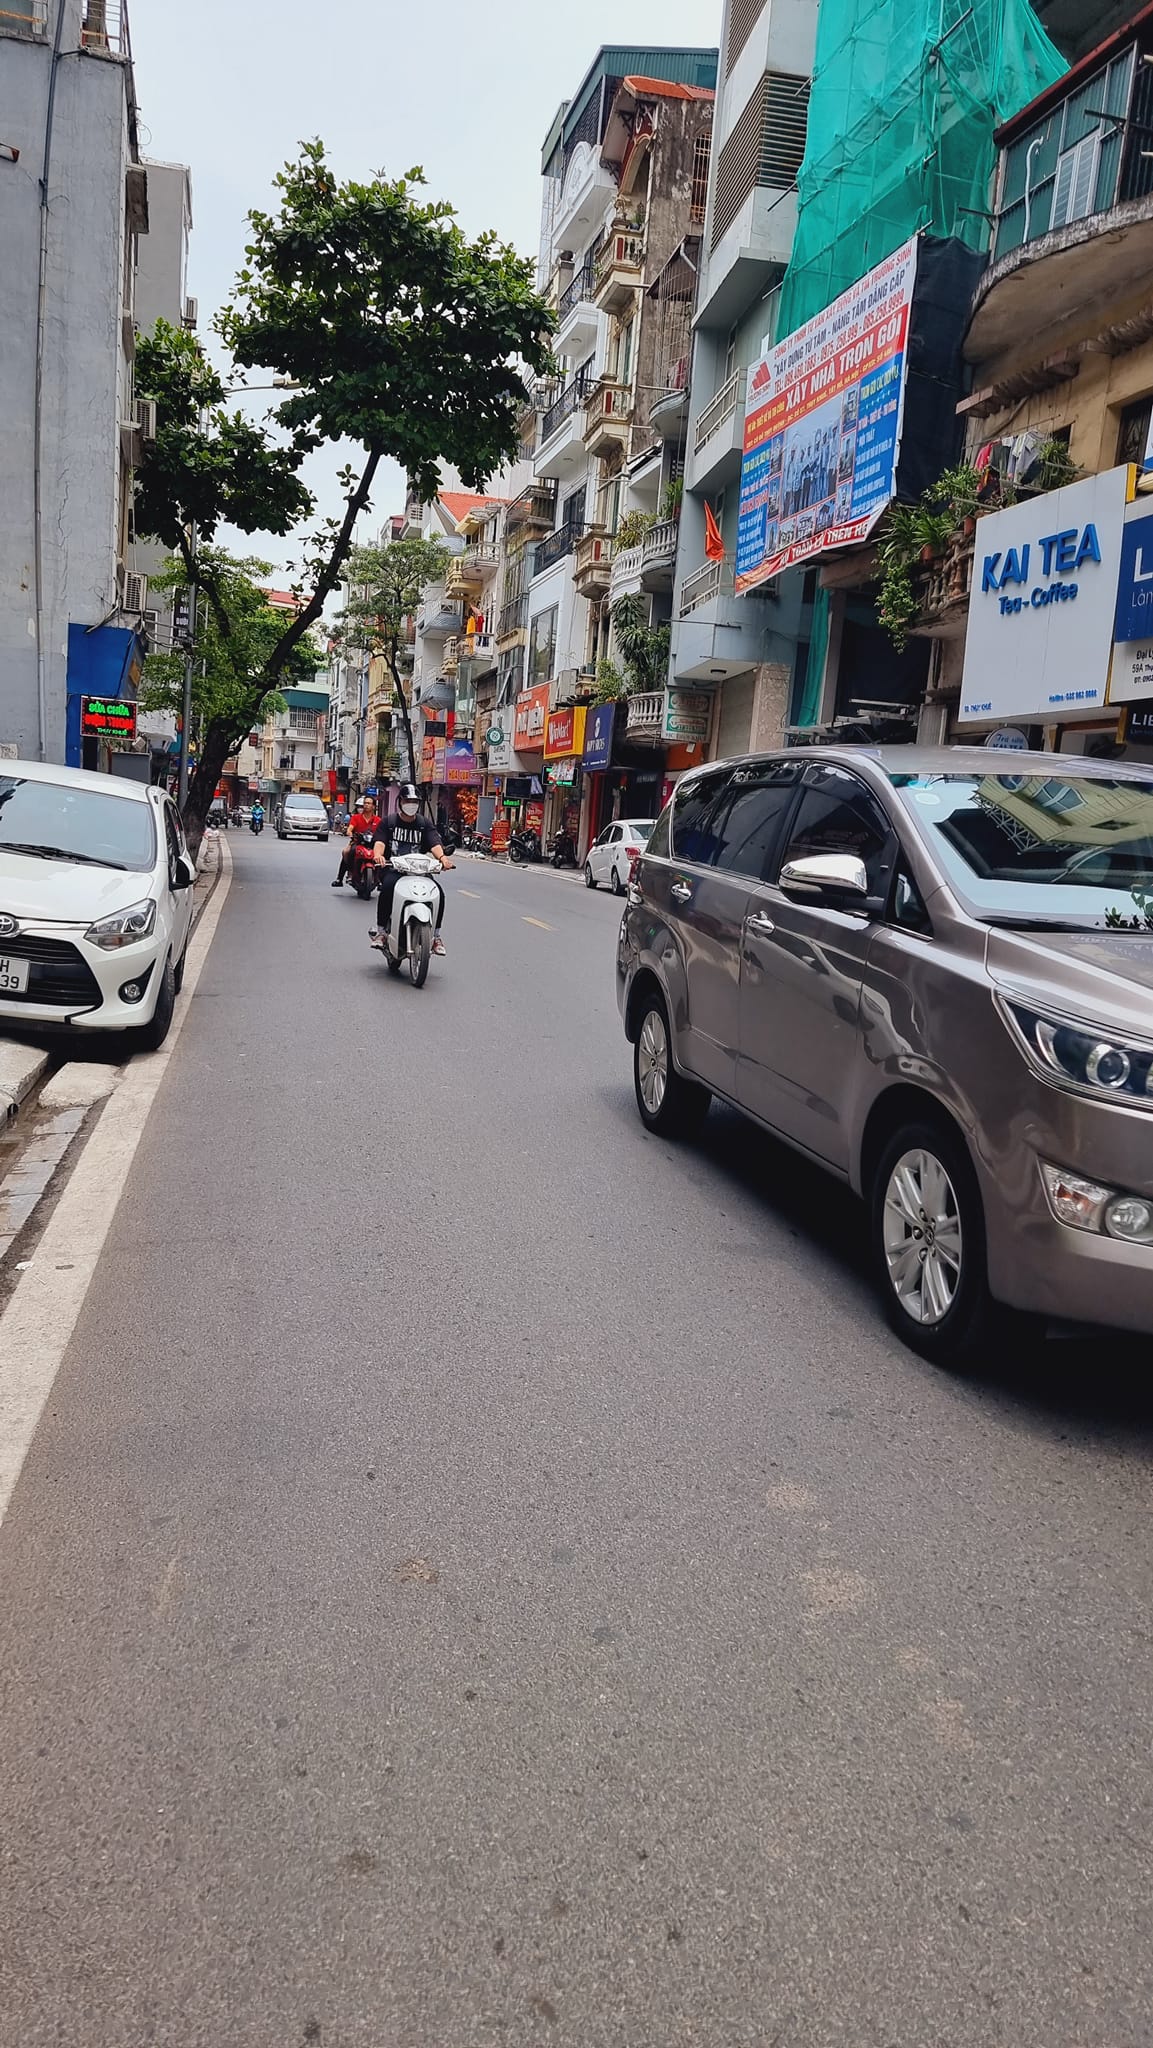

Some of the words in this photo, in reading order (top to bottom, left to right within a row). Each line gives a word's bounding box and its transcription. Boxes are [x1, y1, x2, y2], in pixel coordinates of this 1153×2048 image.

[785, 376, 808, 412] XÂY
[810, 356, 837, 395] NHÀ
[837, 333, 874, 379] TRỌN
[876, 311, 903, 350] GÓI
[982, 543, 1030, 593] KAI
[1038, 523, 1101, 576] TEA
[0, 975, 19, 989] 39
